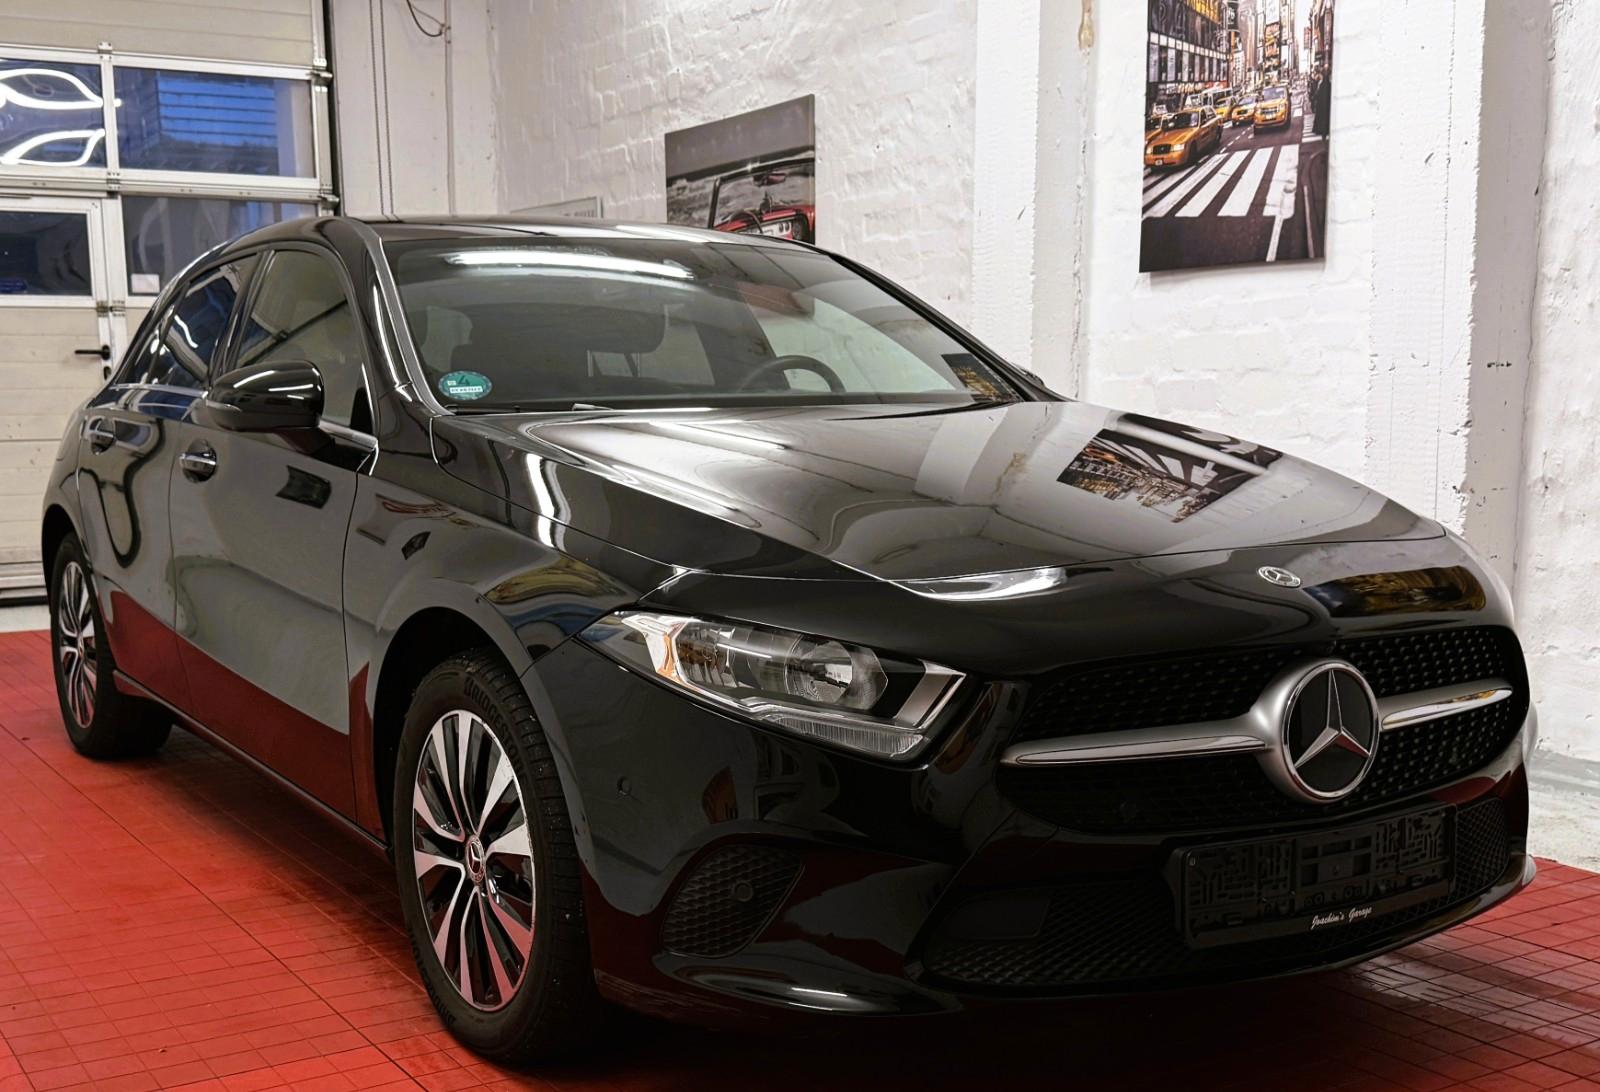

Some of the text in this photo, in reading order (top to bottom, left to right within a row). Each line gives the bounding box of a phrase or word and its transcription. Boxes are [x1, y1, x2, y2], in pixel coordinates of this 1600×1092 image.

[463, 676, 530, 784] BRIDGESTONE
[1310, 907, 1372, 931] Joachim's Garage
